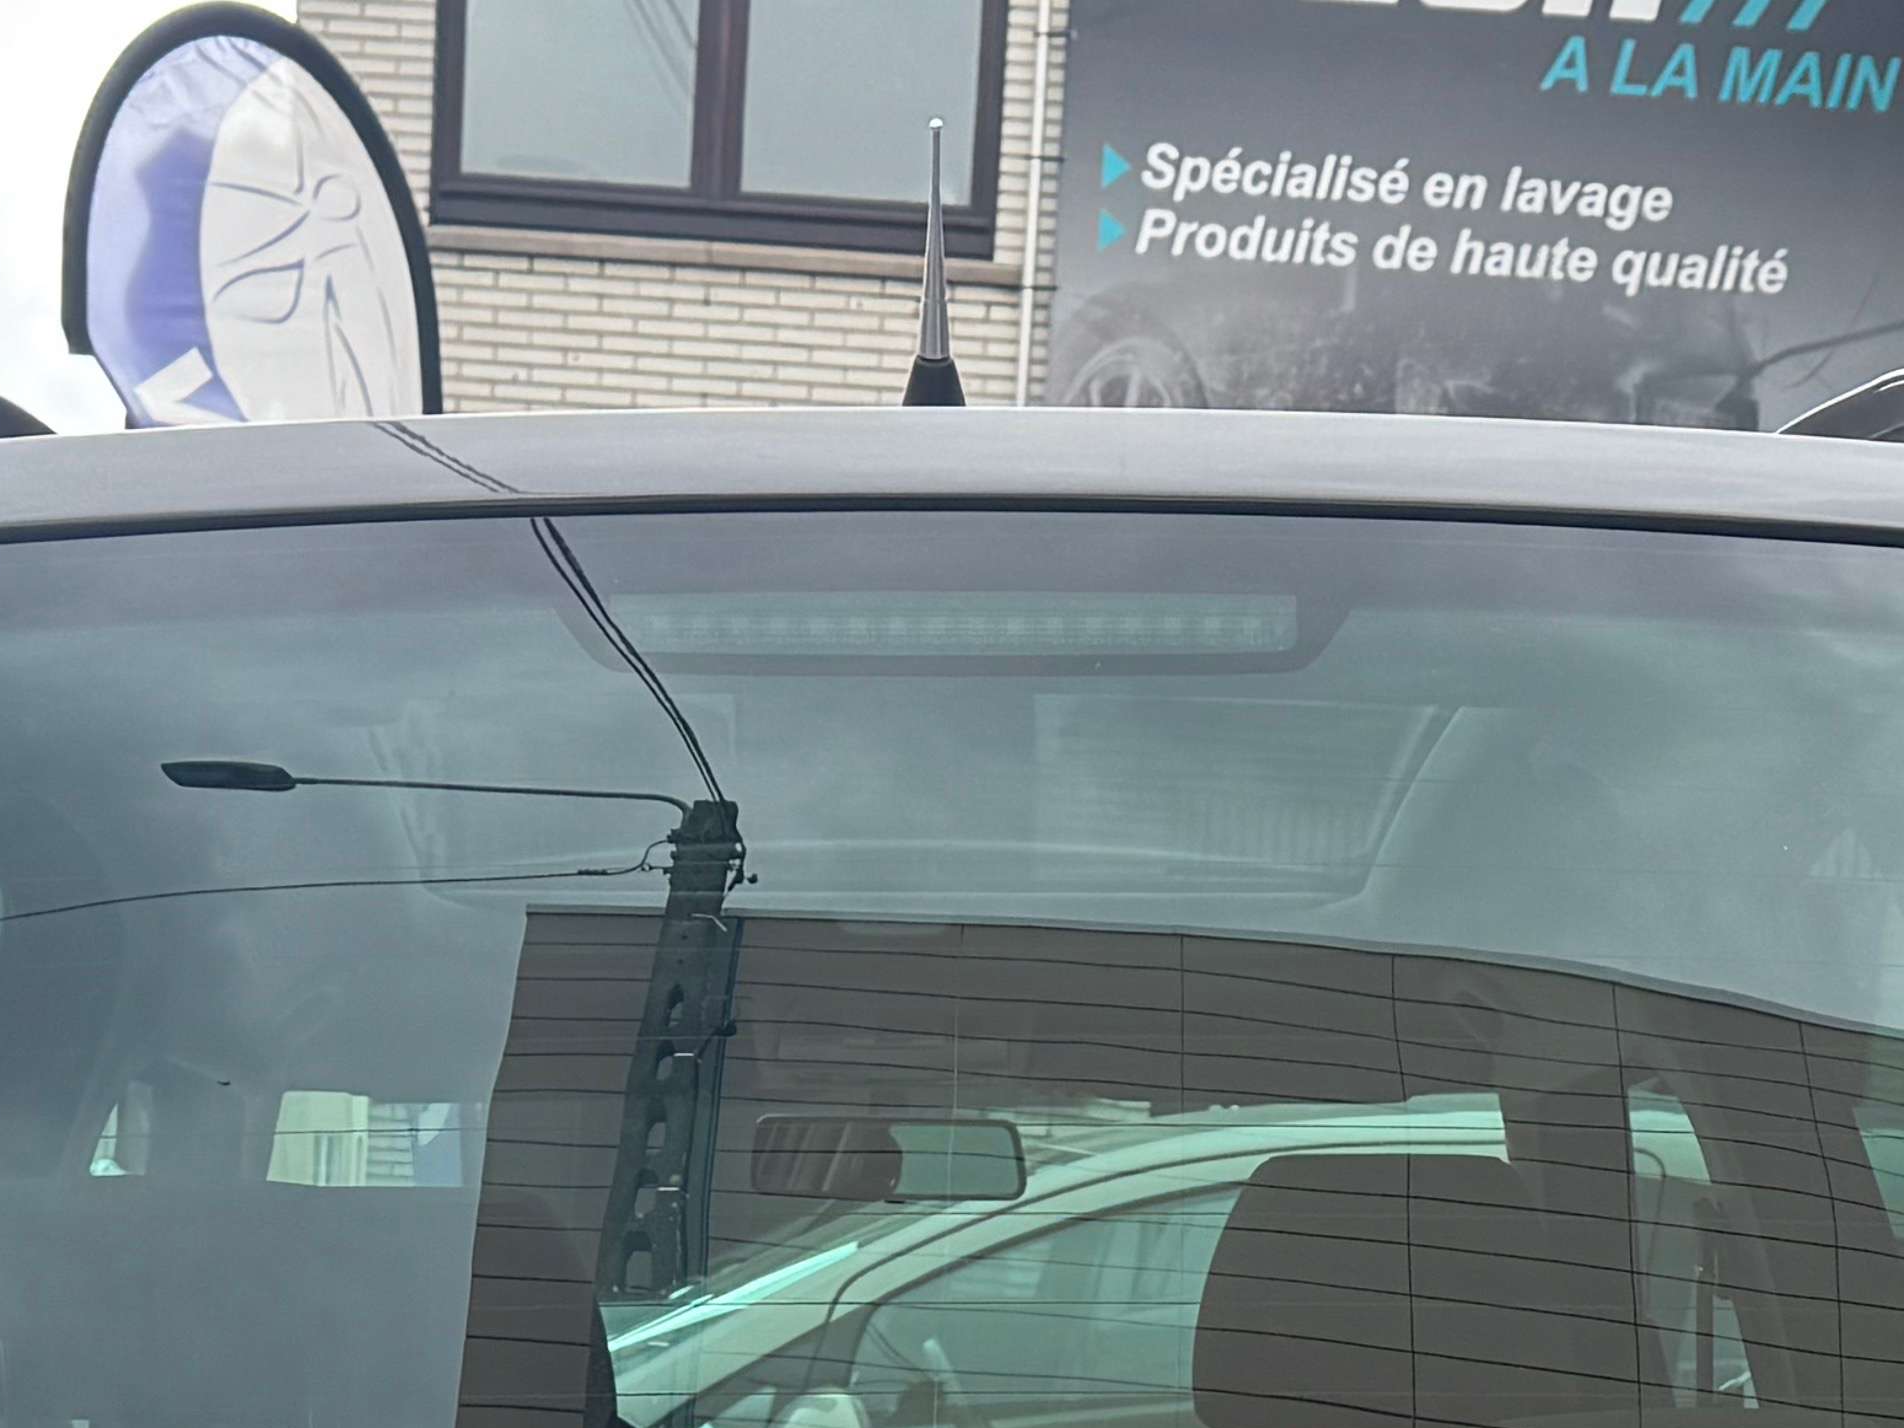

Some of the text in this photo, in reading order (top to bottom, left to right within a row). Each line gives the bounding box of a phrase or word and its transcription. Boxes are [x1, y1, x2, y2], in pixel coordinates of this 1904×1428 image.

[1540, 35, 1901, 112] A LA MAIN
[1140, 141, 1673, 232] Spécialisé en lavage
[1134, 208, 1790, 300] Produits de haute qualité
